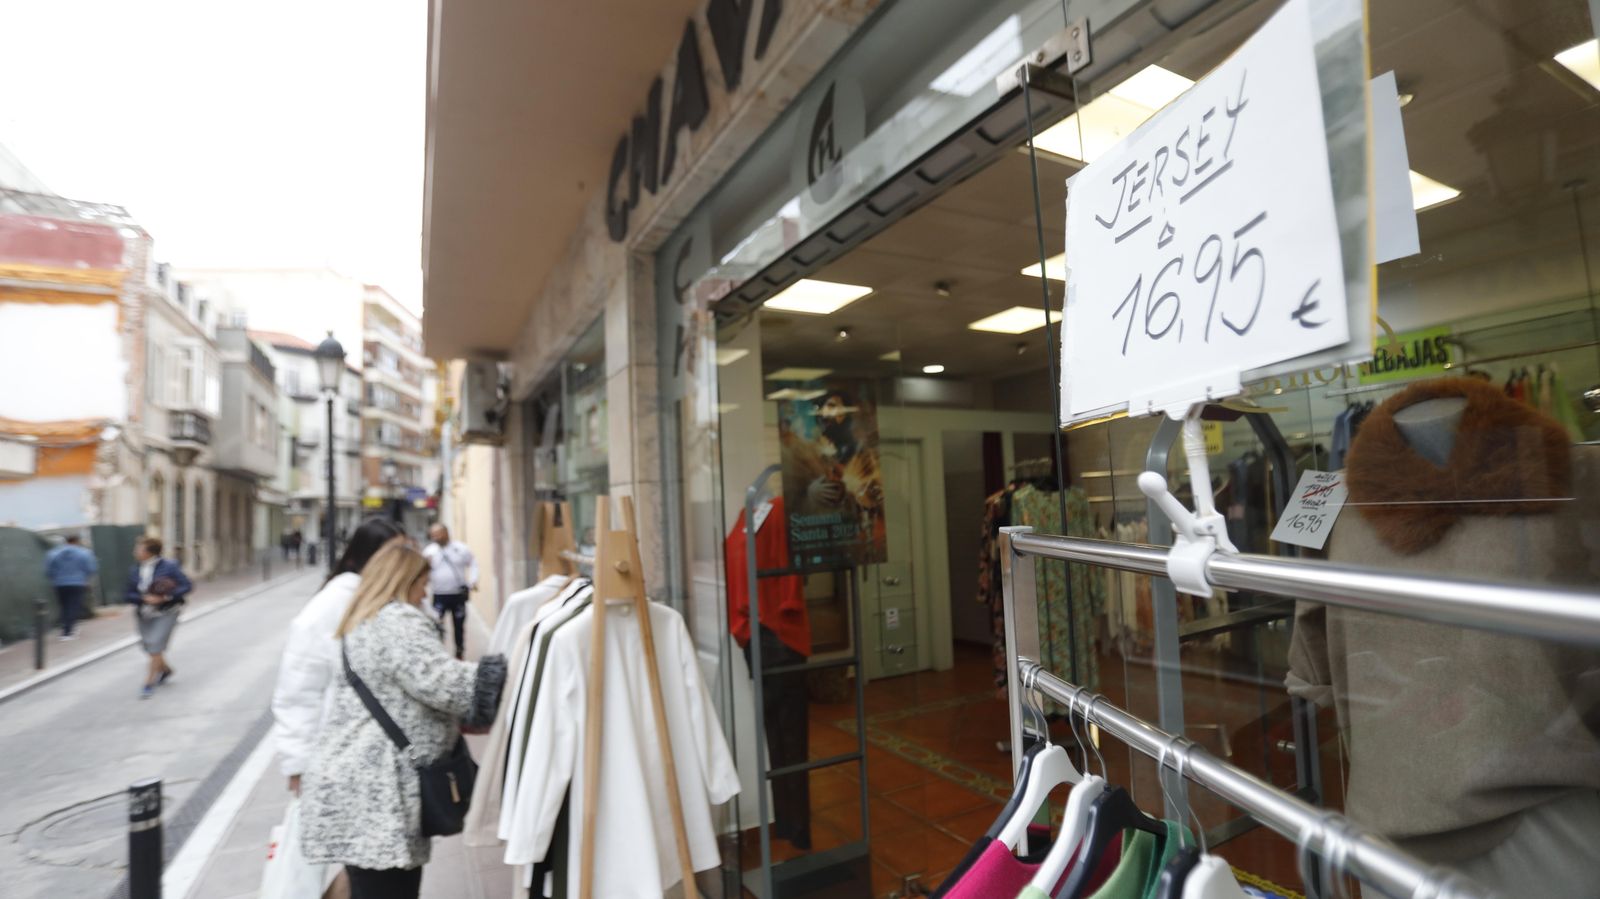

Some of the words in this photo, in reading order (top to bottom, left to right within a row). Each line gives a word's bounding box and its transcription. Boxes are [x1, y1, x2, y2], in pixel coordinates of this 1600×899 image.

[1095, 67, 1249, 229] JERSEY
[1112, 211, 1268, 357] 16,95
[1291, 277, 1331, 329] €
[1286, 513, 1327, 533] 16,95
